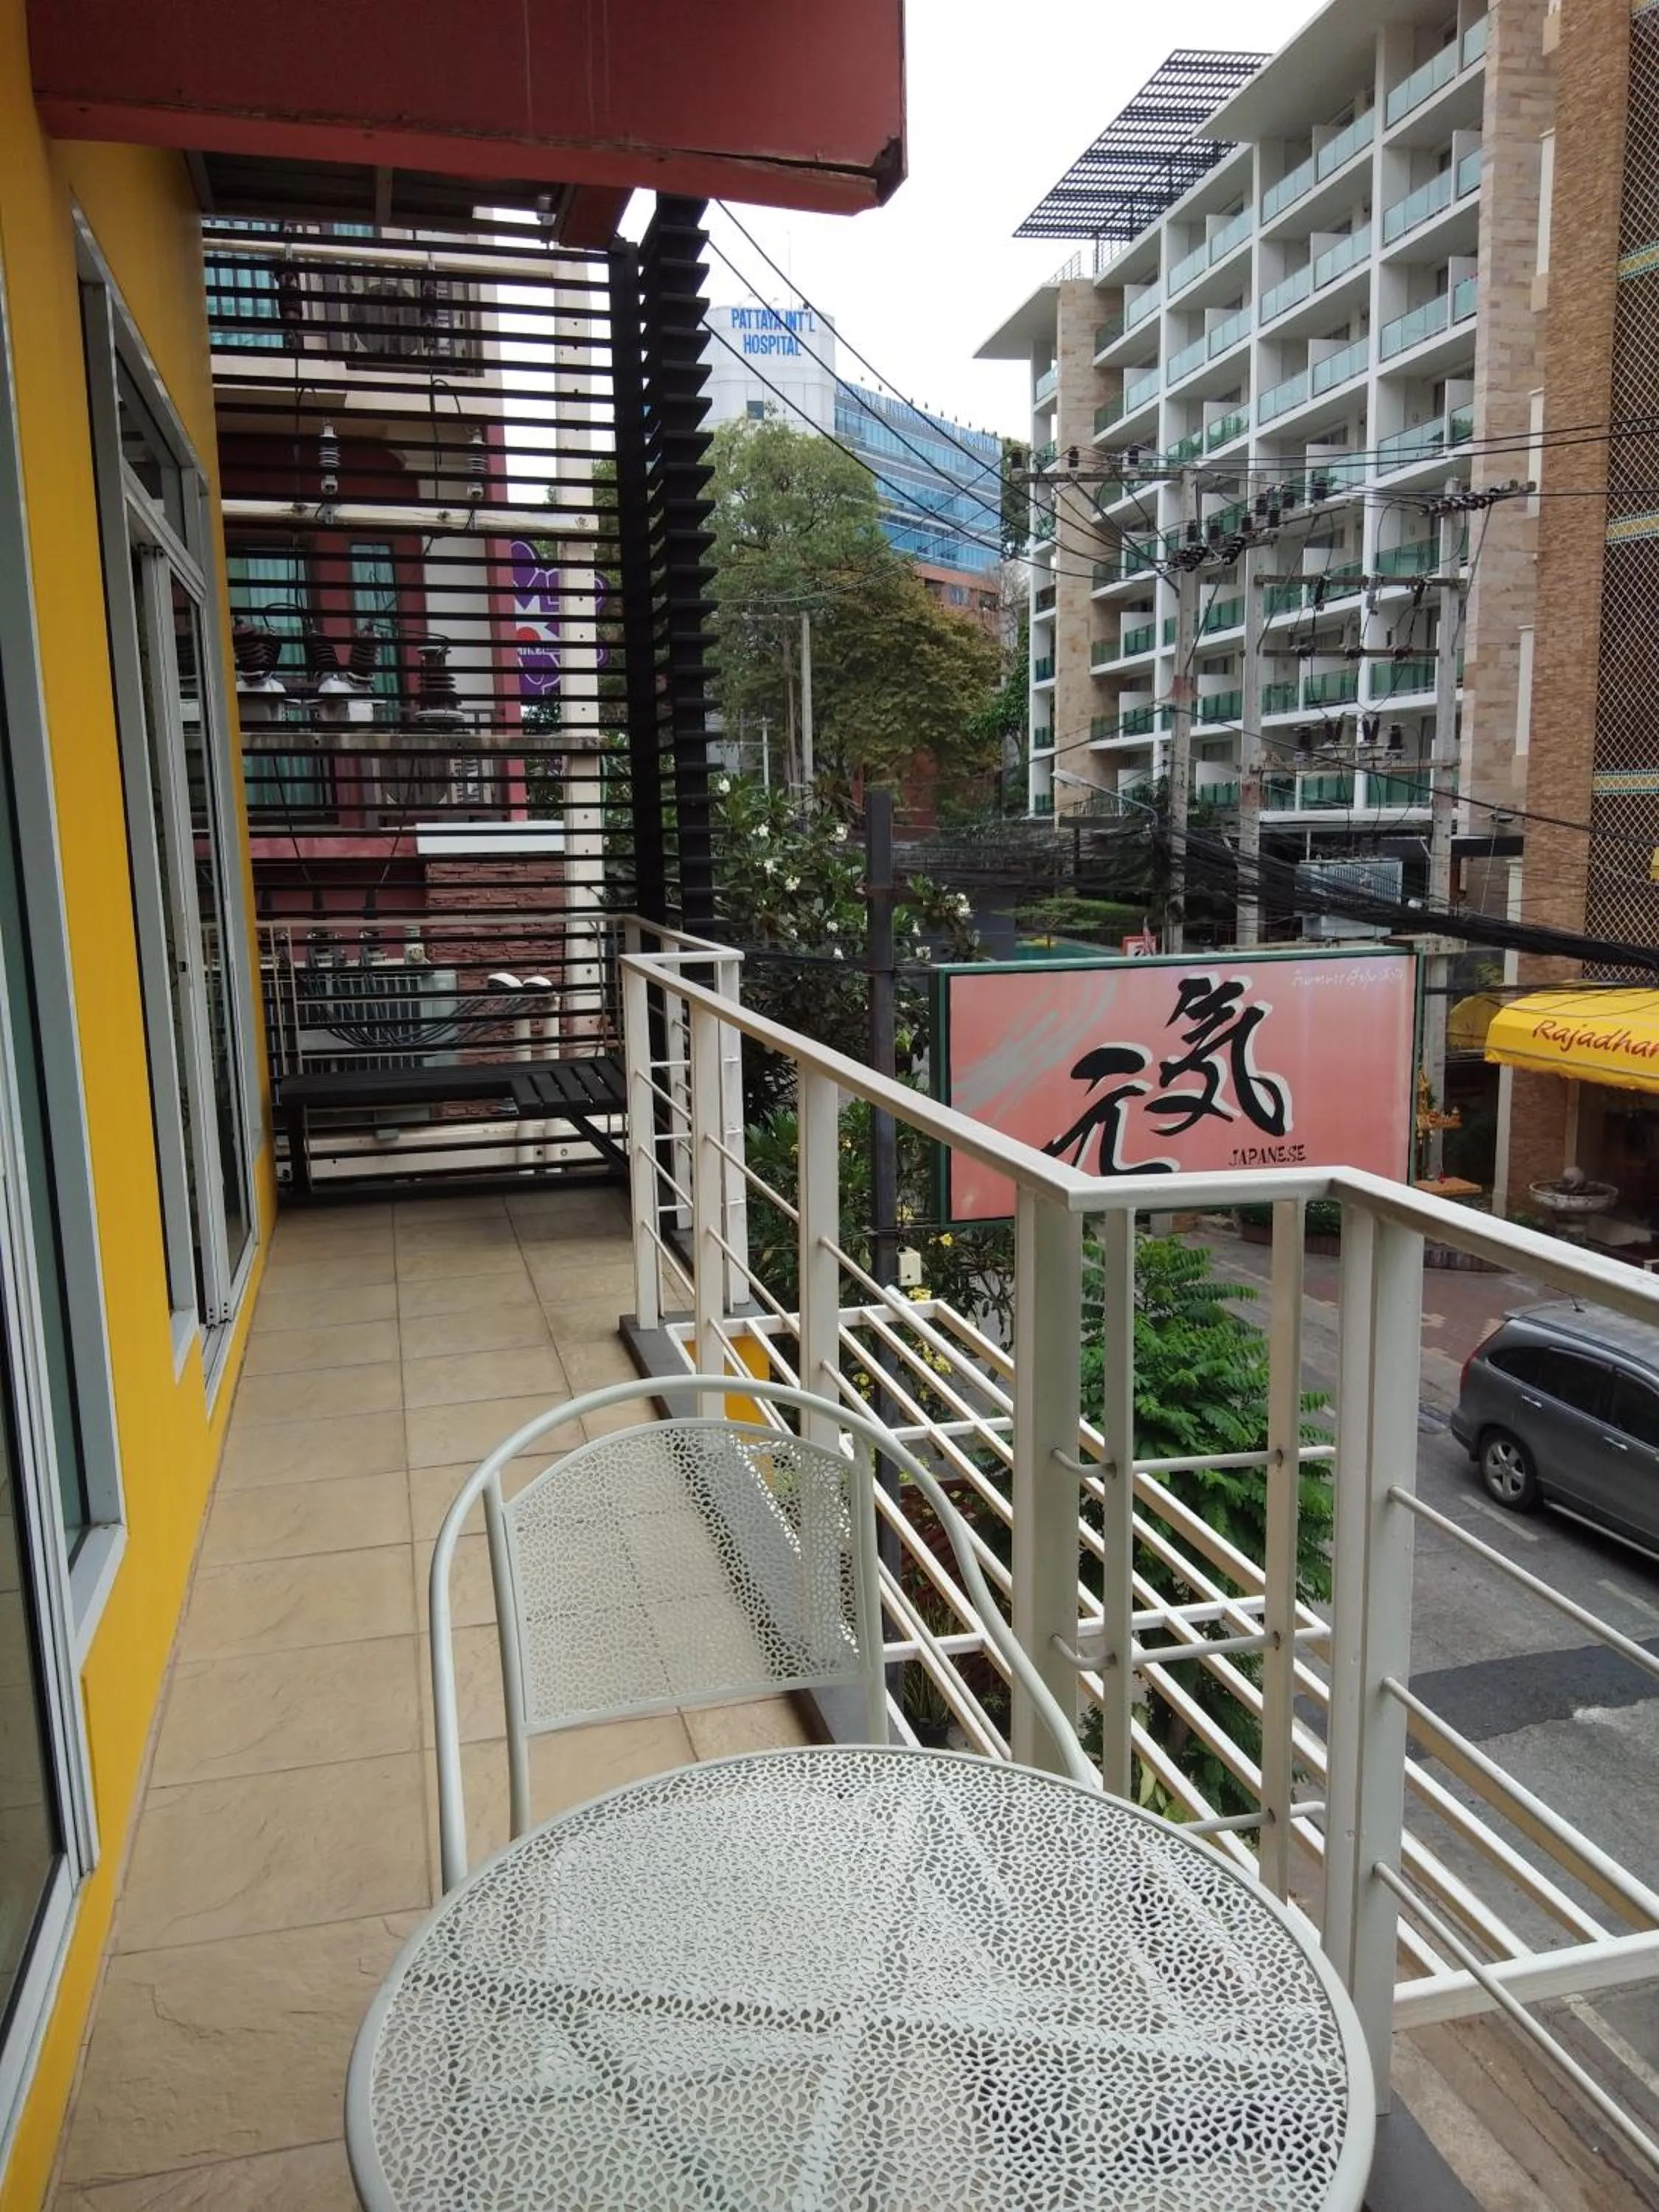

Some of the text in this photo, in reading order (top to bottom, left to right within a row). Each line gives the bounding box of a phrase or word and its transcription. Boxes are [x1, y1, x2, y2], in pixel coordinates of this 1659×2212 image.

[731, 307, 815, 333] PATTAYA INT'L
[743, 333, 801, 356] HOSPITAL
[1228, 1144, 1306, 1166] JAPANESE
